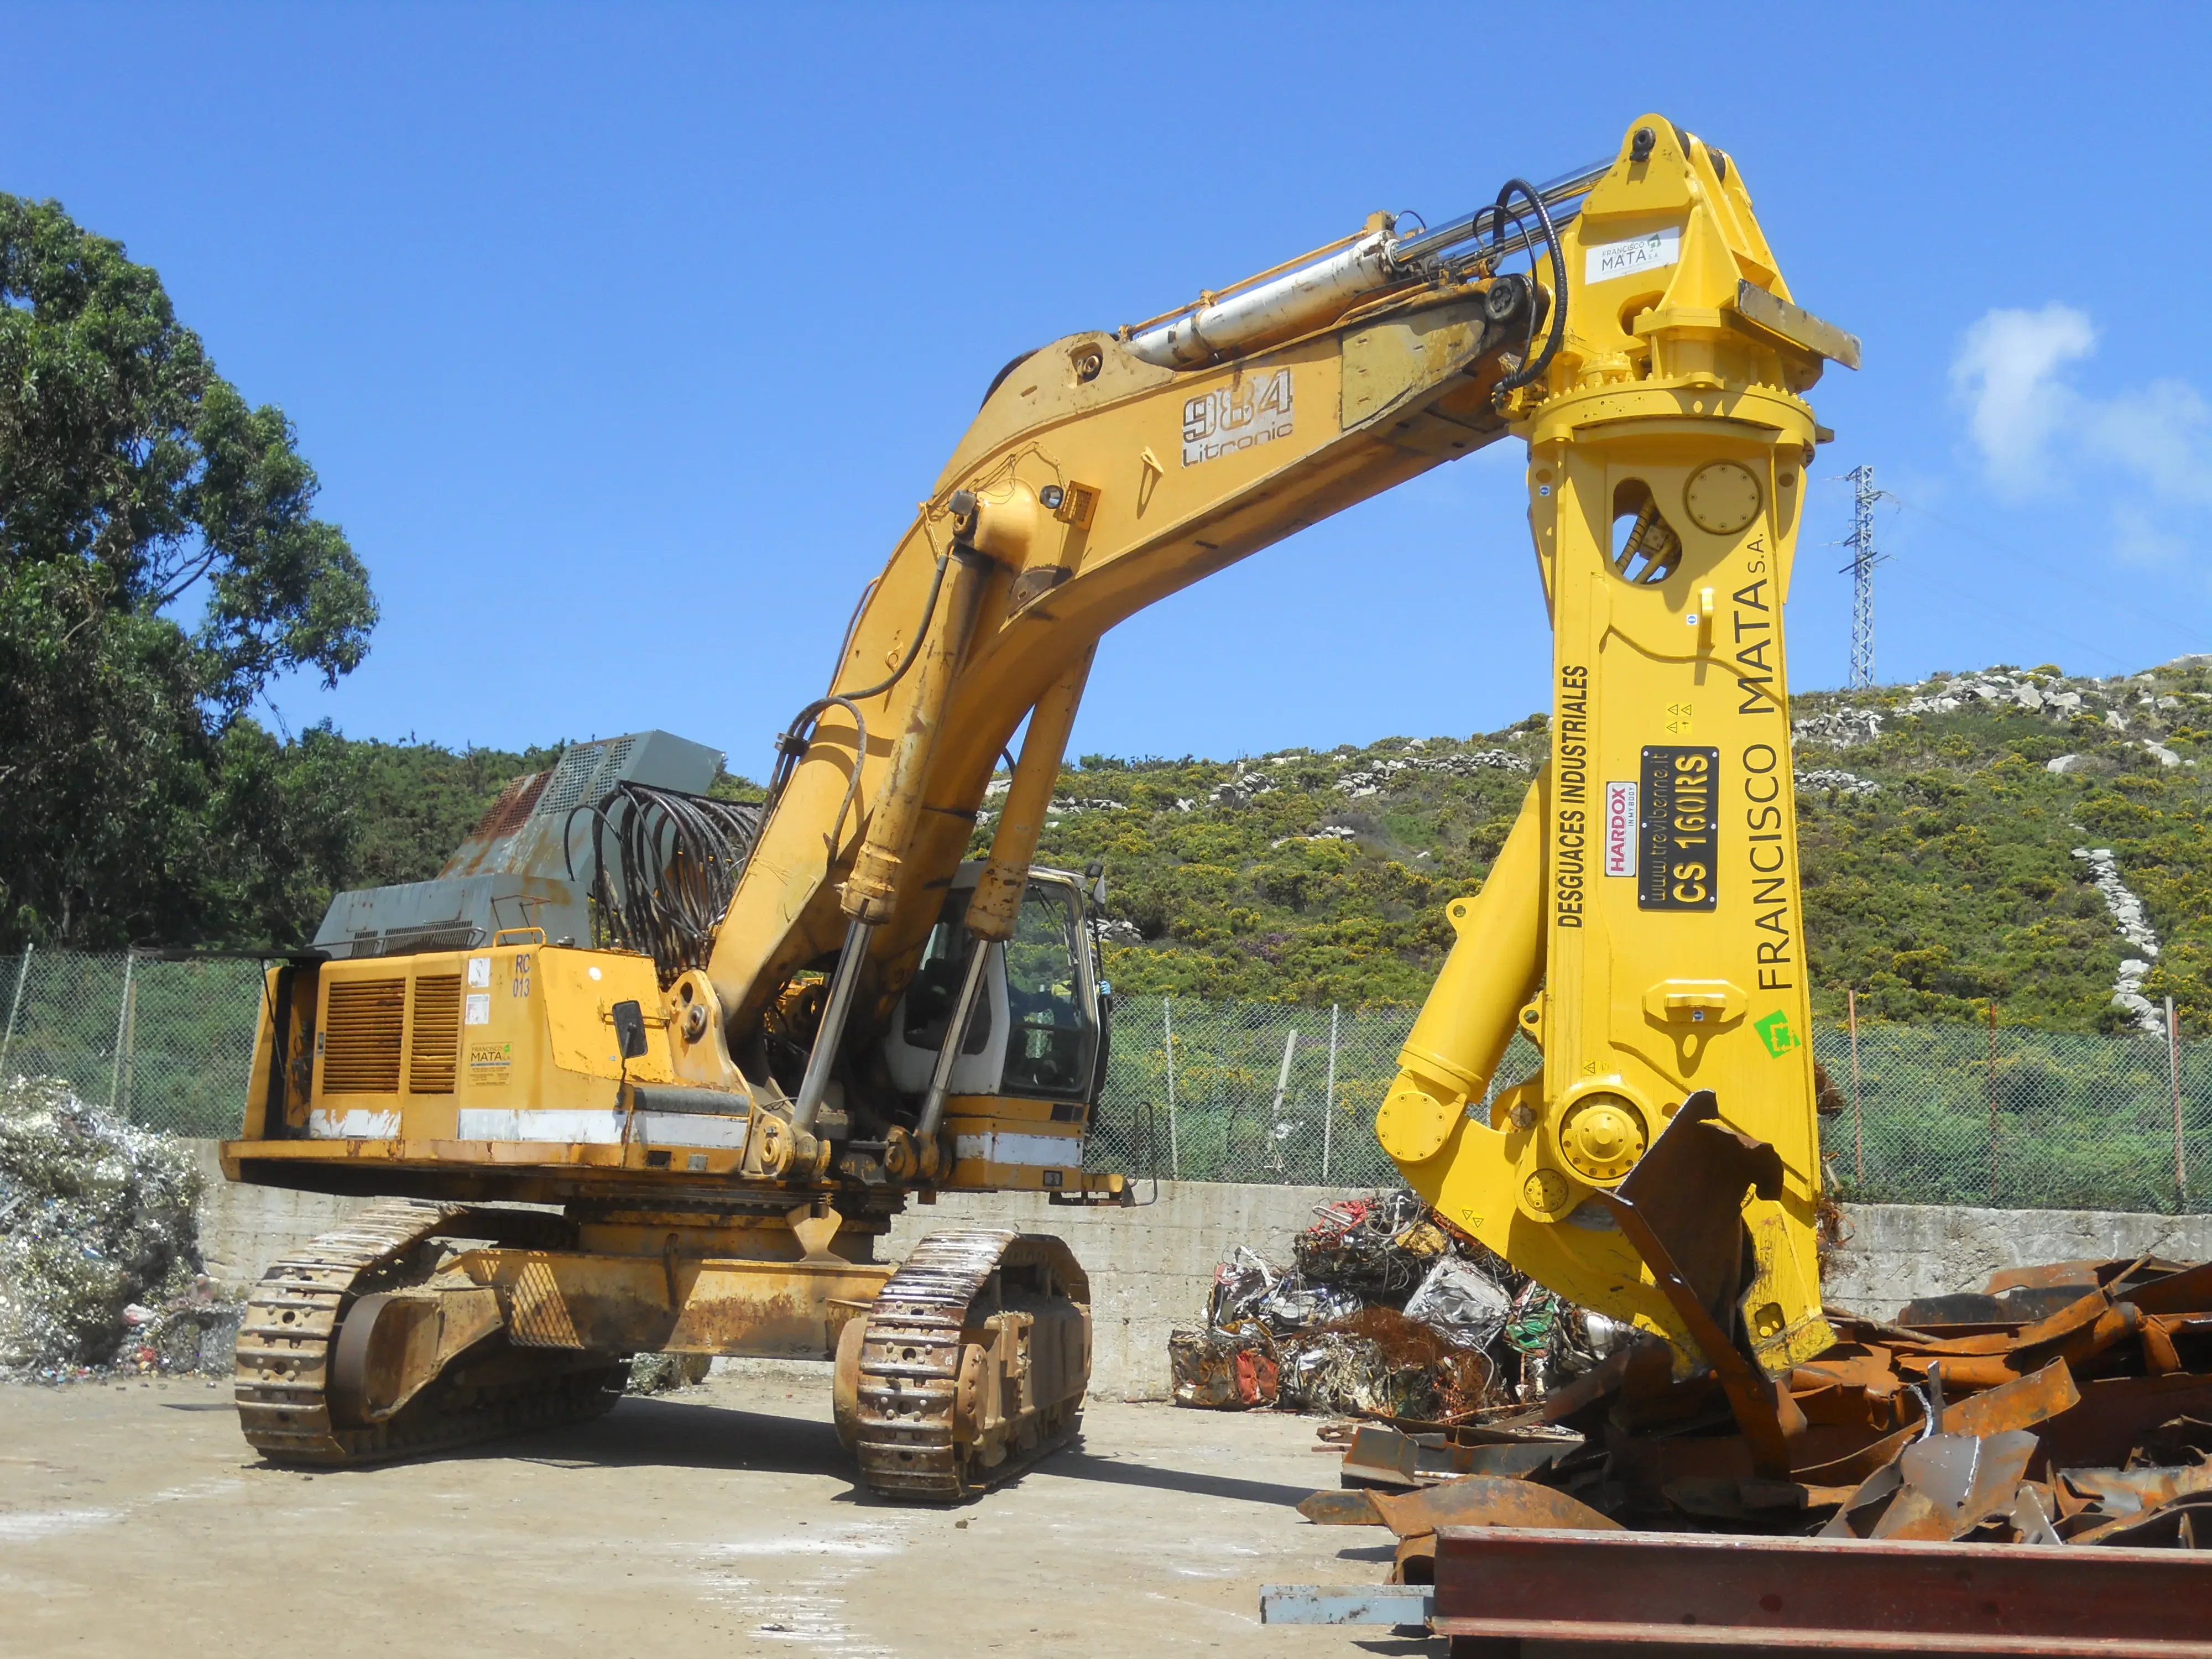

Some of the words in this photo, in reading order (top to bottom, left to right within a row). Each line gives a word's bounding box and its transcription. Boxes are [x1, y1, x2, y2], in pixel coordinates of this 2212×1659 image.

[1602, 242, 1645, 257] FRANCISCO
[1602, 249, 1646, 271] MATA
[1183, 366, 1293, 444] 984
[1182, 422, 1293, 467] Litronic
[1746, 533, 1766, 574] S.A.
[1733, 578, 1775, 714] MATA
[1560, 665, 1588, 804] INDUSTRIALES
[1610, 787, 1626, 872] HARDOX
[1628, 807, 1635, 818] MY
[1628, 818, 1635, 827] IN
[1647, 753, 1669, 902] www.trevibenne.it
[1557, 809, 1585, 928] DESGUACES
[1672, 861, 1707, 903] CS
[1742, 743, 1793, 990] FRANCISCO
[515, 953, 531, 973] RC
[513, 978, 530, 998] 013
[471, 1051, 502, 1062] MATA
